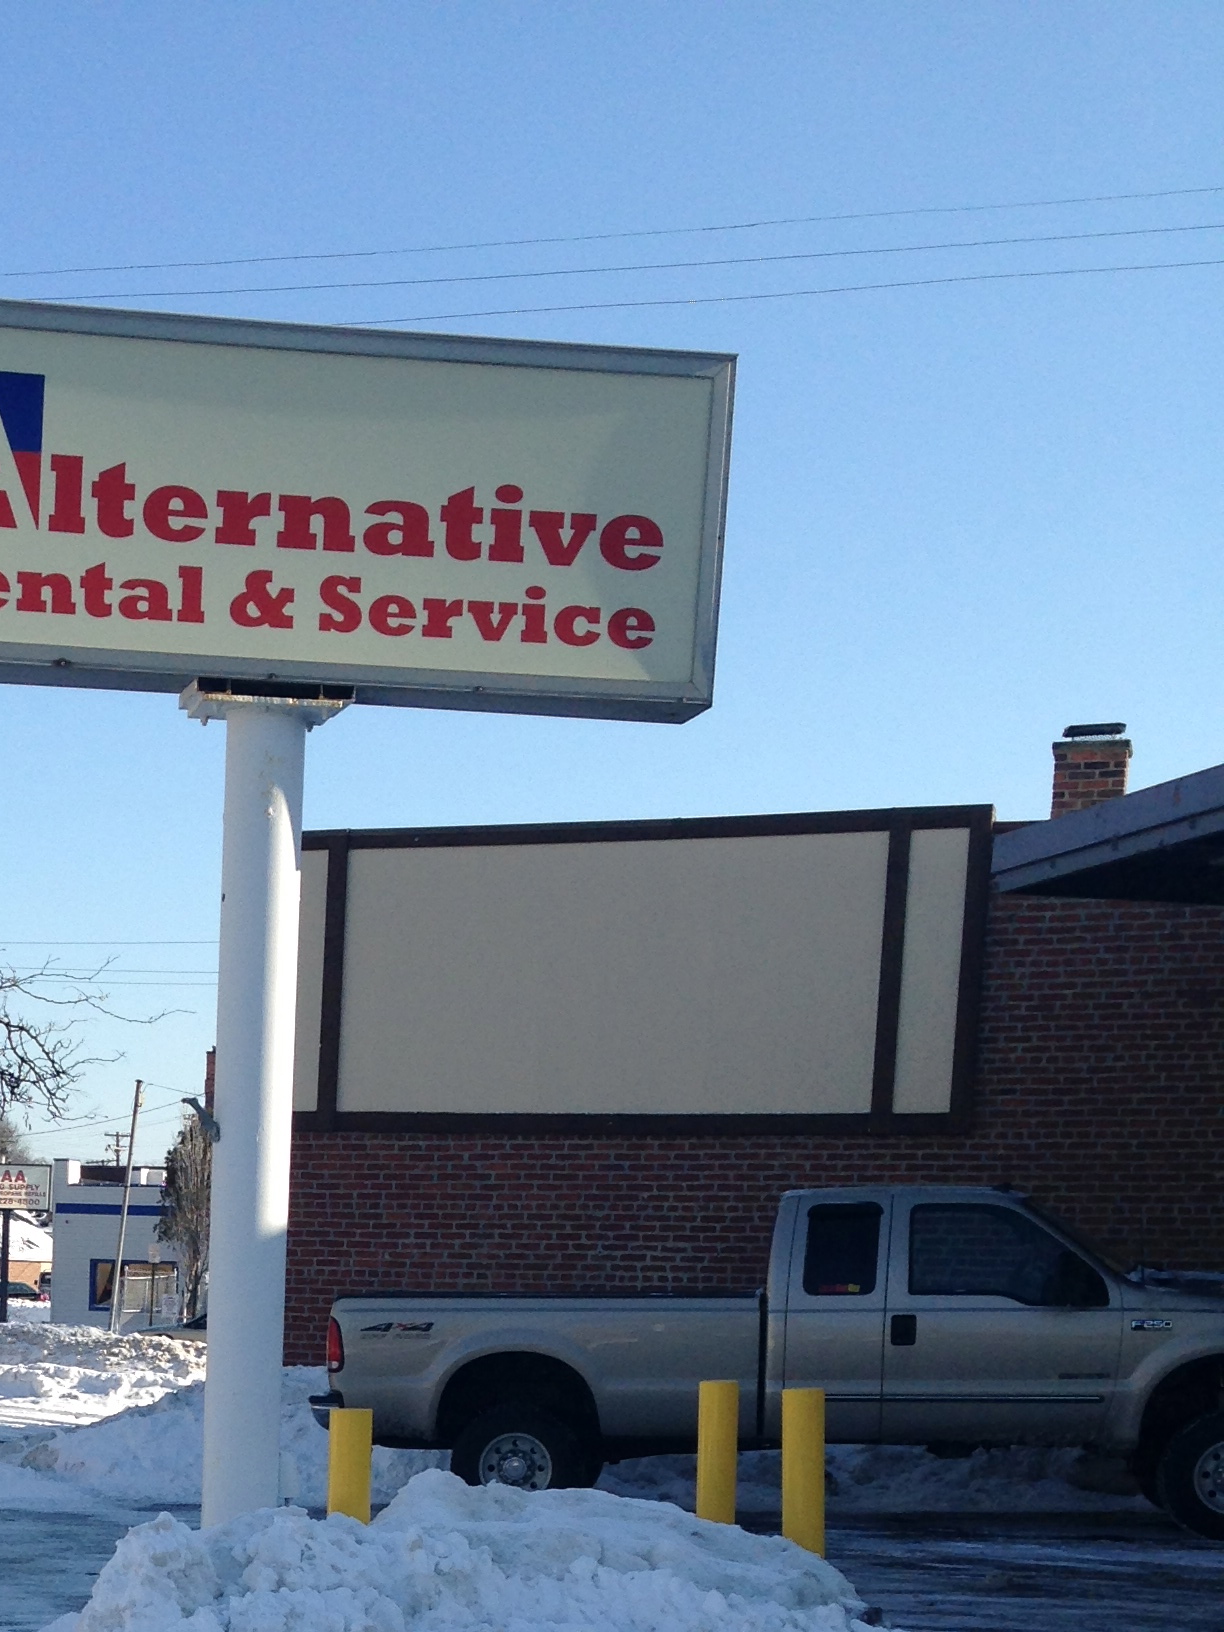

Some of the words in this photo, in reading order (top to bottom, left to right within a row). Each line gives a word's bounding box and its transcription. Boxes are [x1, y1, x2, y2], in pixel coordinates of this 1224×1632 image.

[229, 569, 294, 628] &
[318, 574, 656, 650] Service
[8, 1183, 41, 1191] SUPPLY
